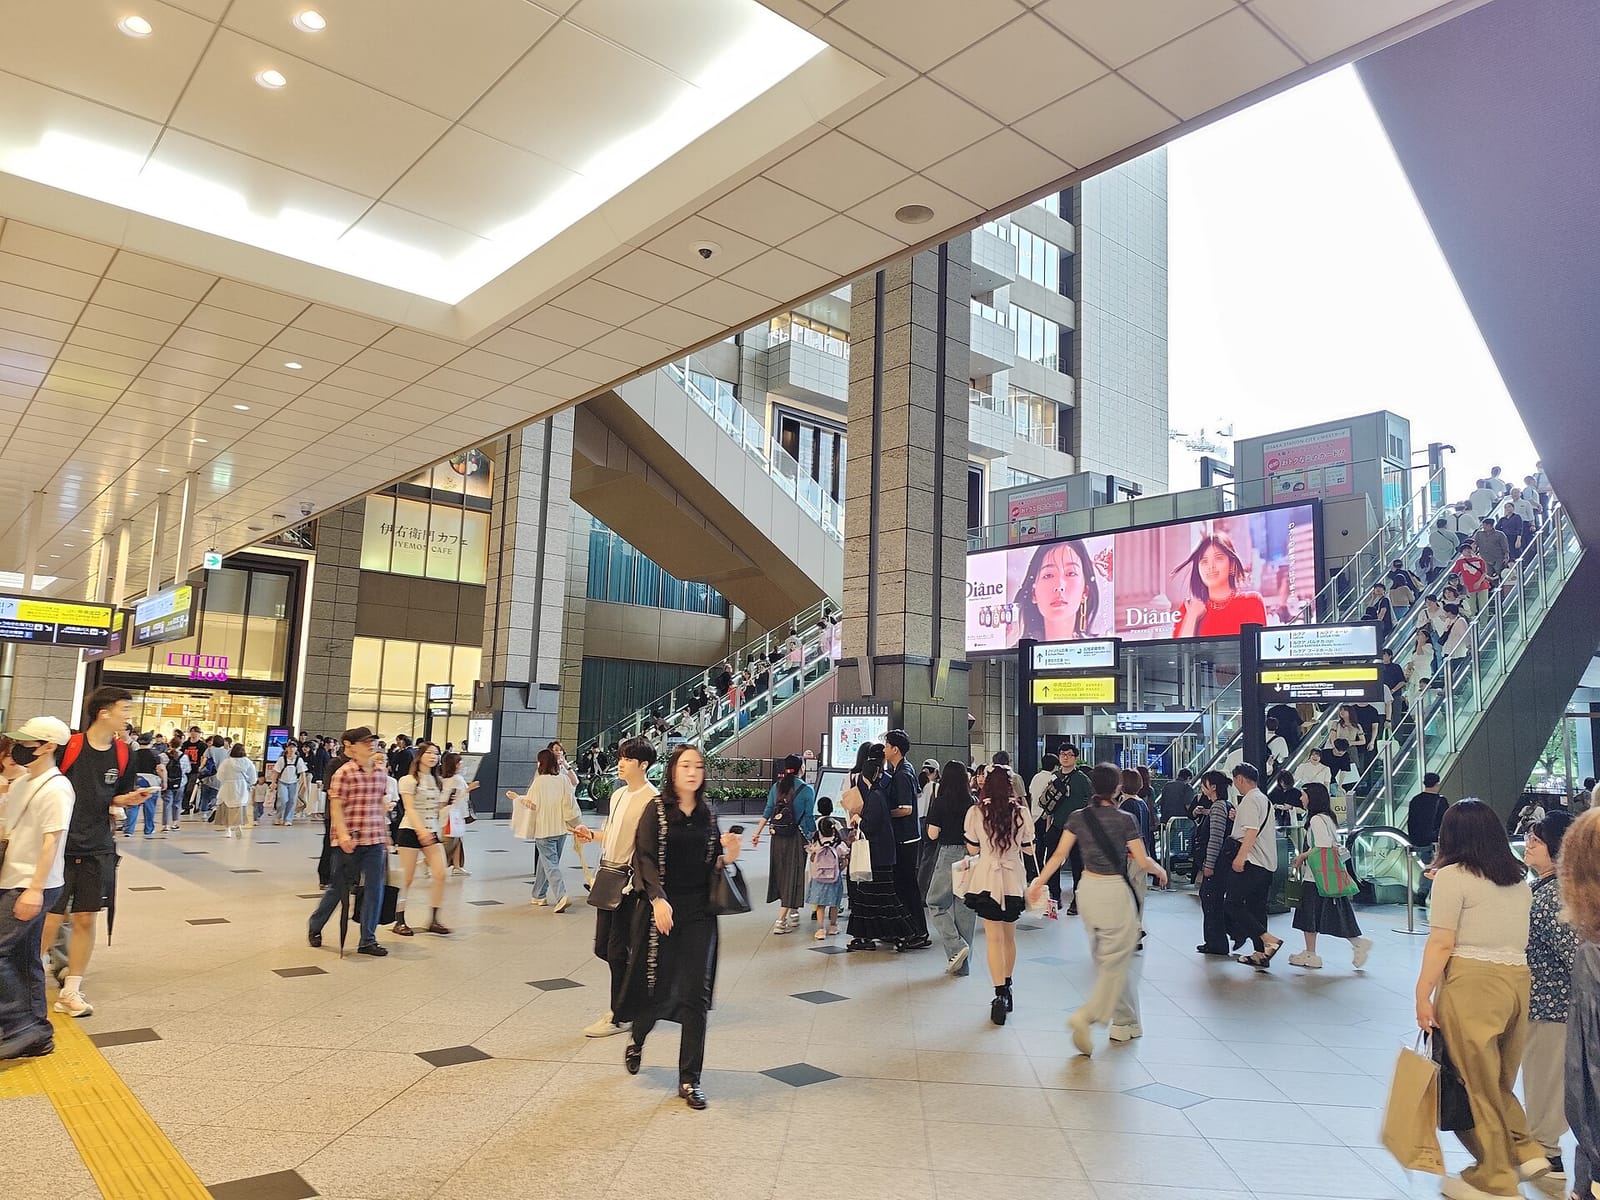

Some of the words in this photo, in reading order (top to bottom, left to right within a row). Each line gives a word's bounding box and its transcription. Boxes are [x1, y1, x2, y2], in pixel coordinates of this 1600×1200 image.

[380, 522, 435, 542] 伊右衛門
[438, 532, 469, 546] カフェ
[431, 545, 454, 555] CAFE
[1125, 607, 1183, 626] Diâne
[842, 703, 889, 715] information
[1177, 831, 1189, 851] 1F
